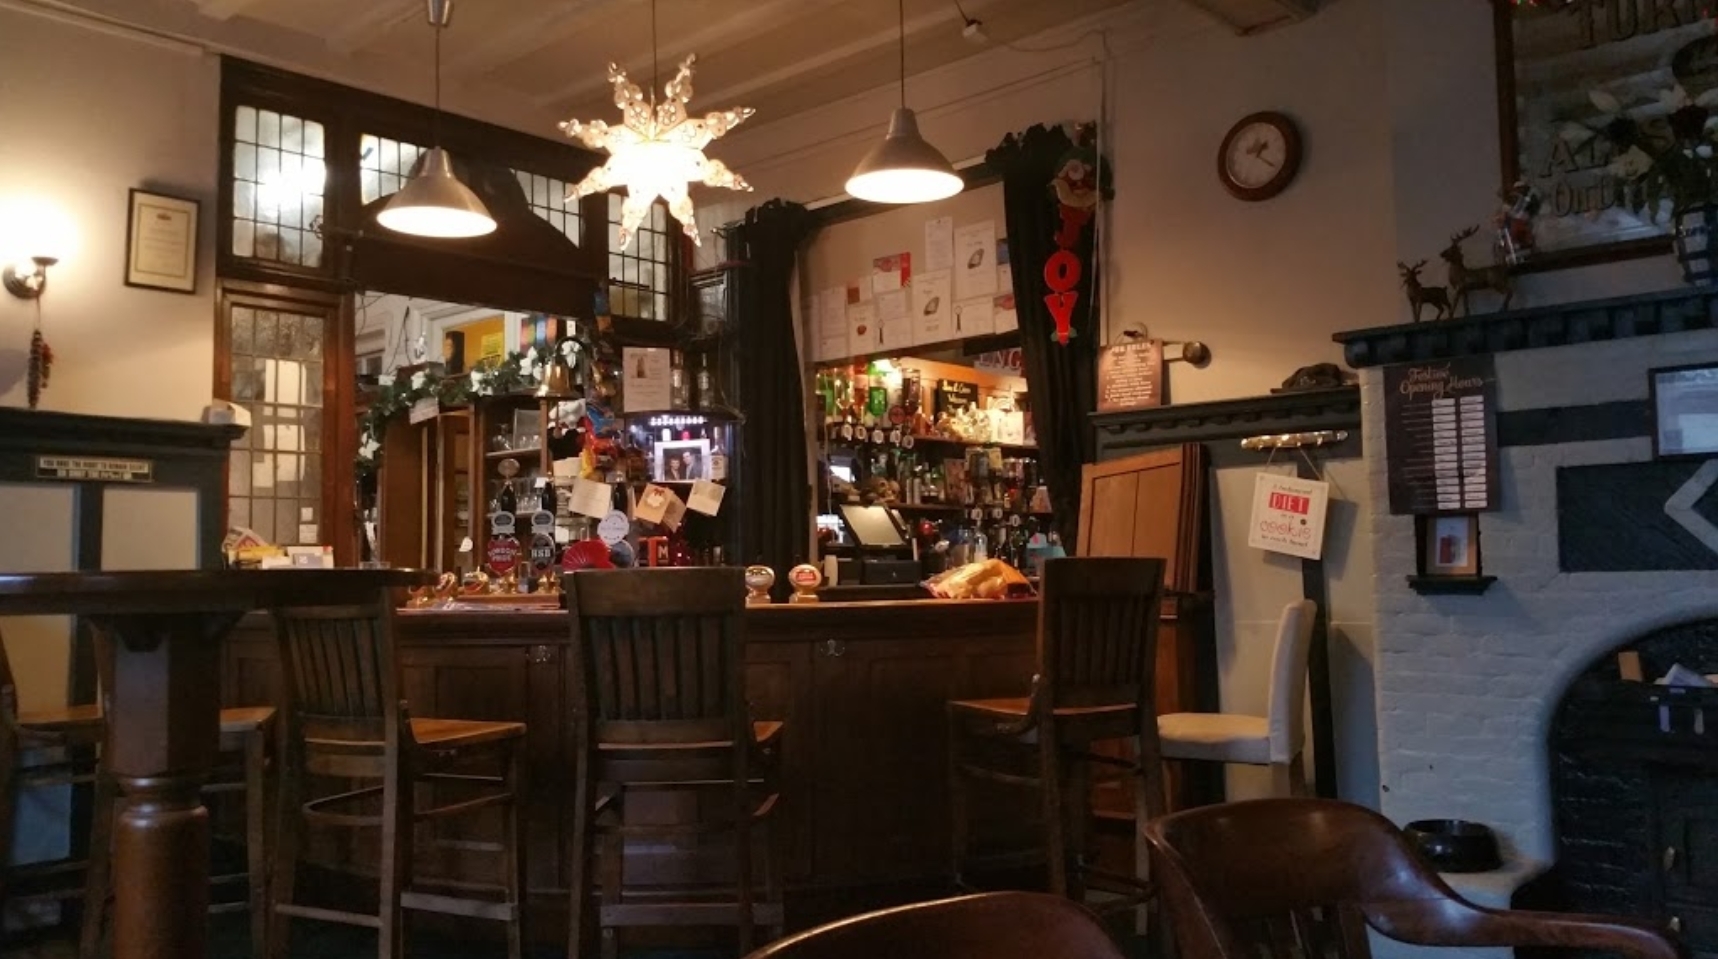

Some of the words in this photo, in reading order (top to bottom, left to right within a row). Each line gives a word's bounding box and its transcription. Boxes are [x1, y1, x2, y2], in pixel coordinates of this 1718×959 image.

[1043, 203, 1092, 346] JOY
[1409, 362, 1451, 383] Festive
[1399, 379, 1445, 400] Opening
[1446, 374, 1484, 393] Hours
[1273, 494, 1304, 512] DIET
